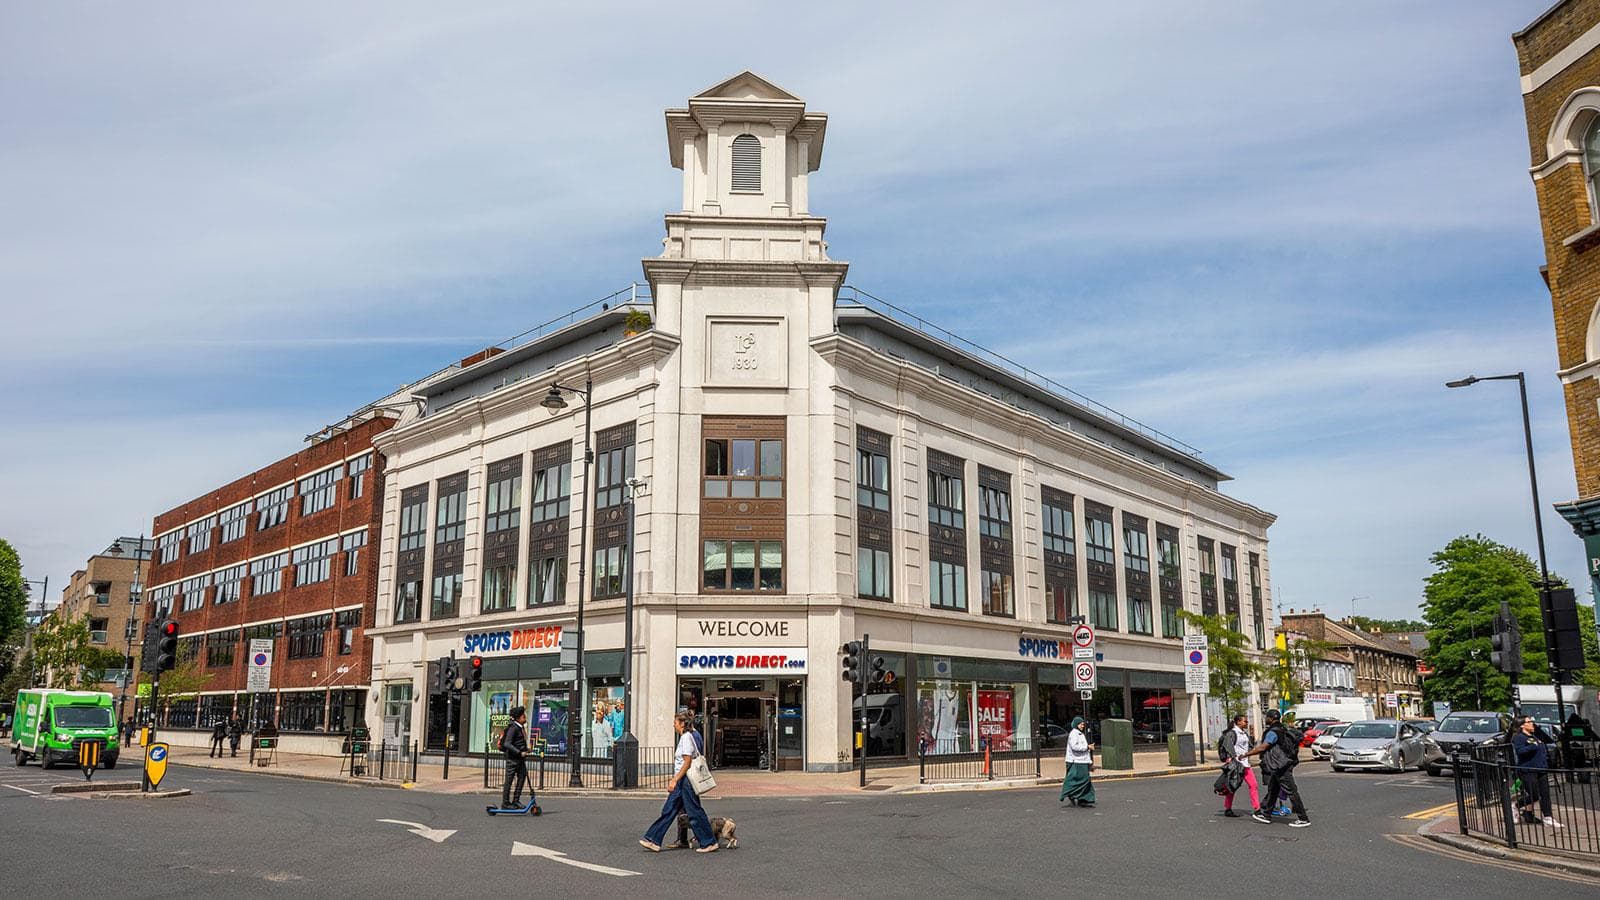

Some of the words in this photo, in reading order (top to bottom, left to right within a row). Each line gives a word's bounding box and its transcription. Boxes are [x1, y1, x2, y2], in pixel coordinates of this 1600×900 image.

[732, 358, 758, 370] 1930
[698, 621, 789, 637] WELCOME
[1019, 637, 1058, 658] SPORTS
[1080, 668, 1090, 676] 20
